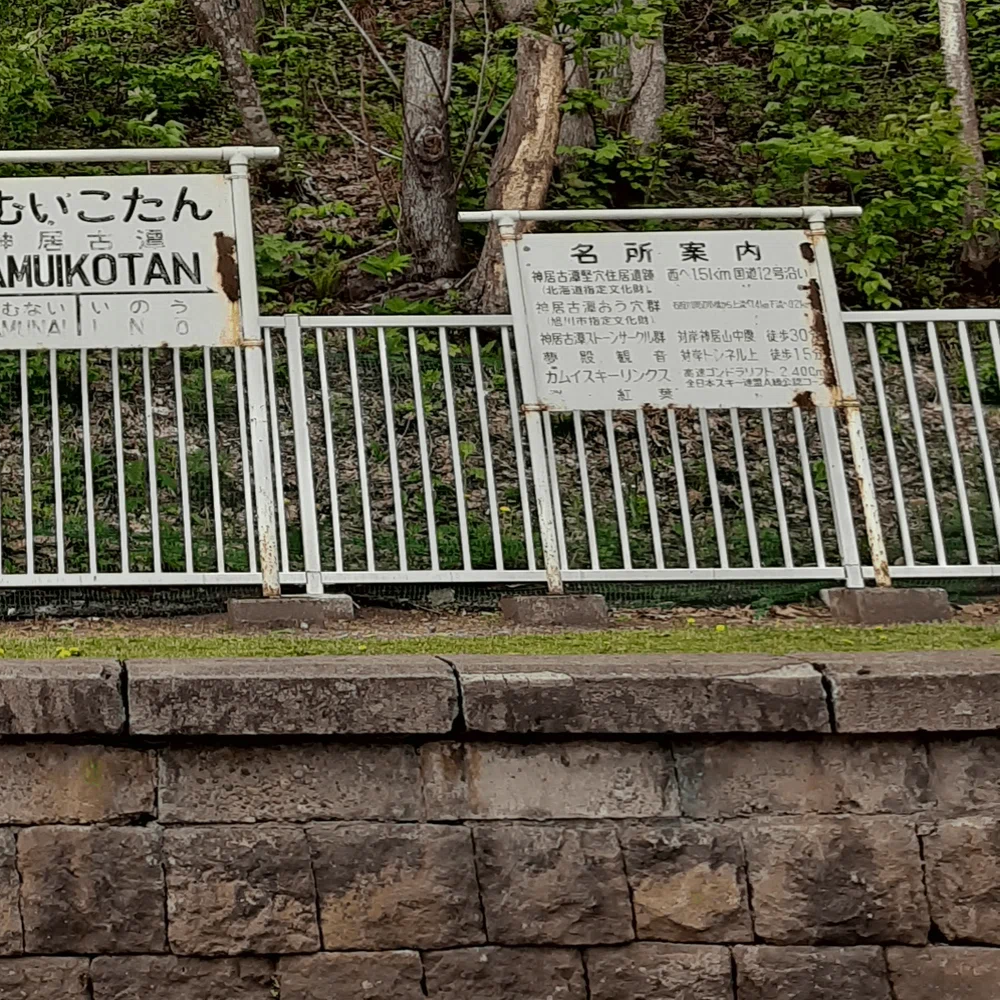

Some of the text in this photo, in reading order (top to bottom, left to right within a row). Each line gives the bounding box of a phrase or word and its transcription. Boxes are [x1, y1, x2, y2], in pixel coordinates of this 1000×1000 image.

[570, 241, 762, 264] 名所案内
[91, 299, 188, 314] いのう
[542, 350, 668, 364] 夢殿観音
[545, 369, 672, 384] カムイスキーリンクス
[617, 388, 673, 401] 紅葉
